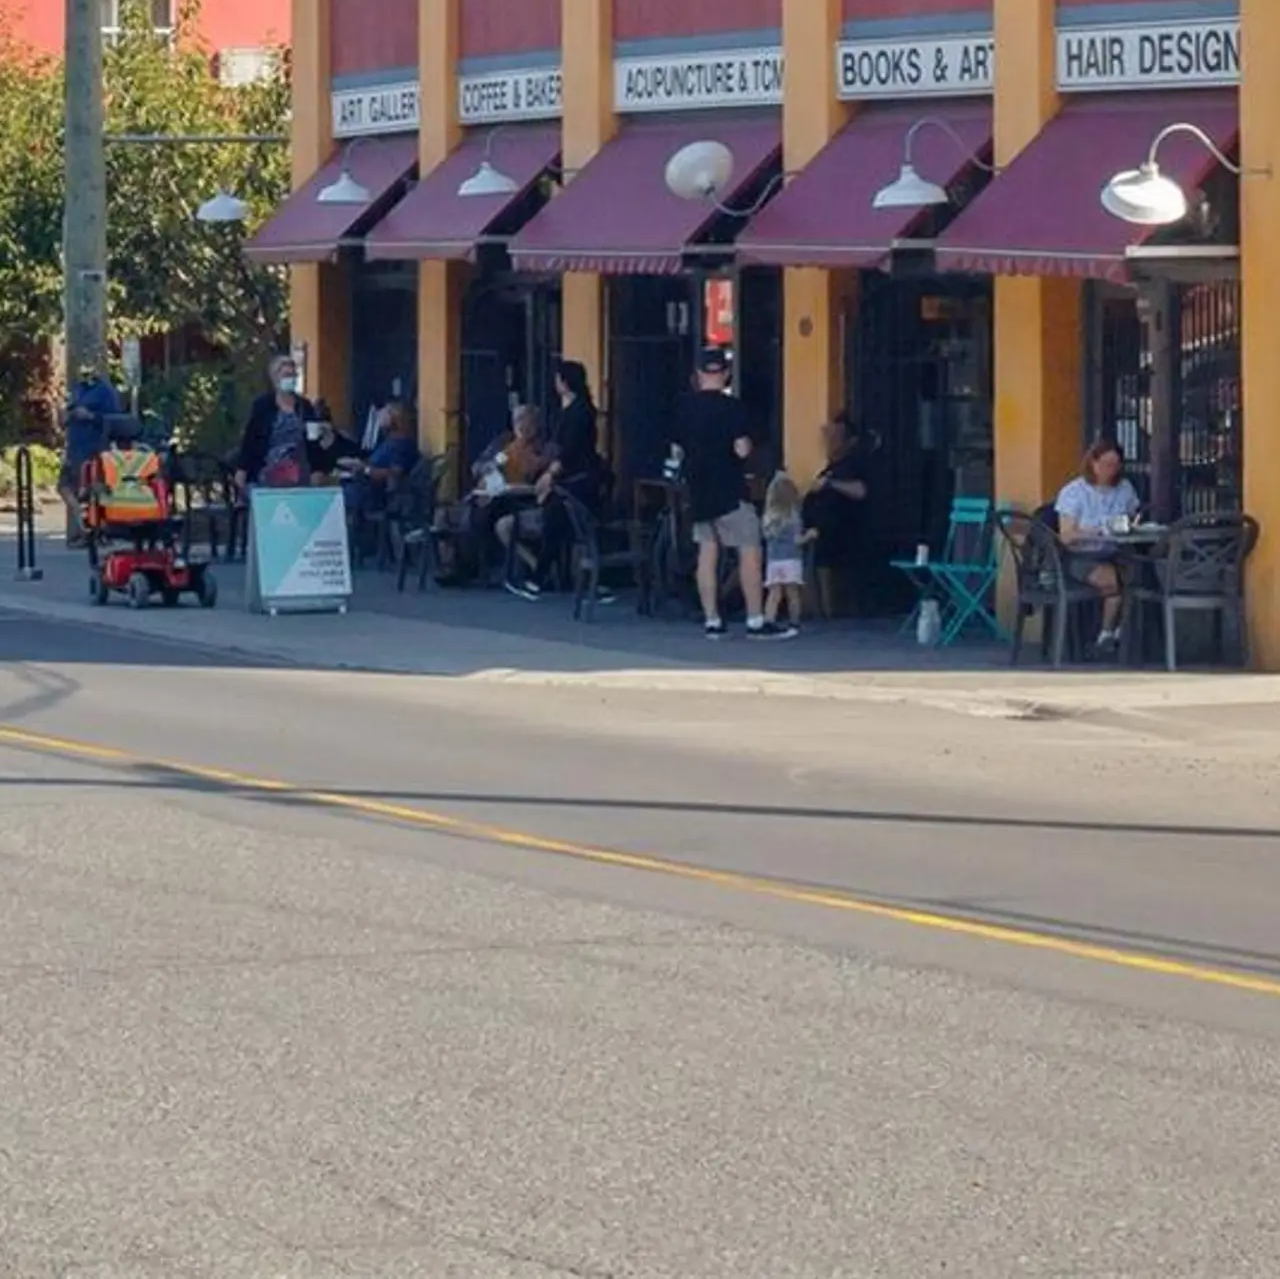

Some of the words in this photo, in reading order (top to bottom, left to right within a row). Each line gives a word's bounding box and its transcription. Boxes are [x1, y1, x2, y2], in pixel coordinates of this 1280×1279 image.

[842, 48, 923, 86] BOOKS
[933, 47, 949, 83] &
[1065, 37, 1124, 78] HAIR
[1139, 30, 1241, 75] DESIGN
[463, 80, 507, 114] COFFEE
[625, 62, 734, 99] ACUPUNCTURE
[738, 61, 747, 92] &
[340, 97, 363, 125] ART
[369, 91, 420, 123] GALLER
